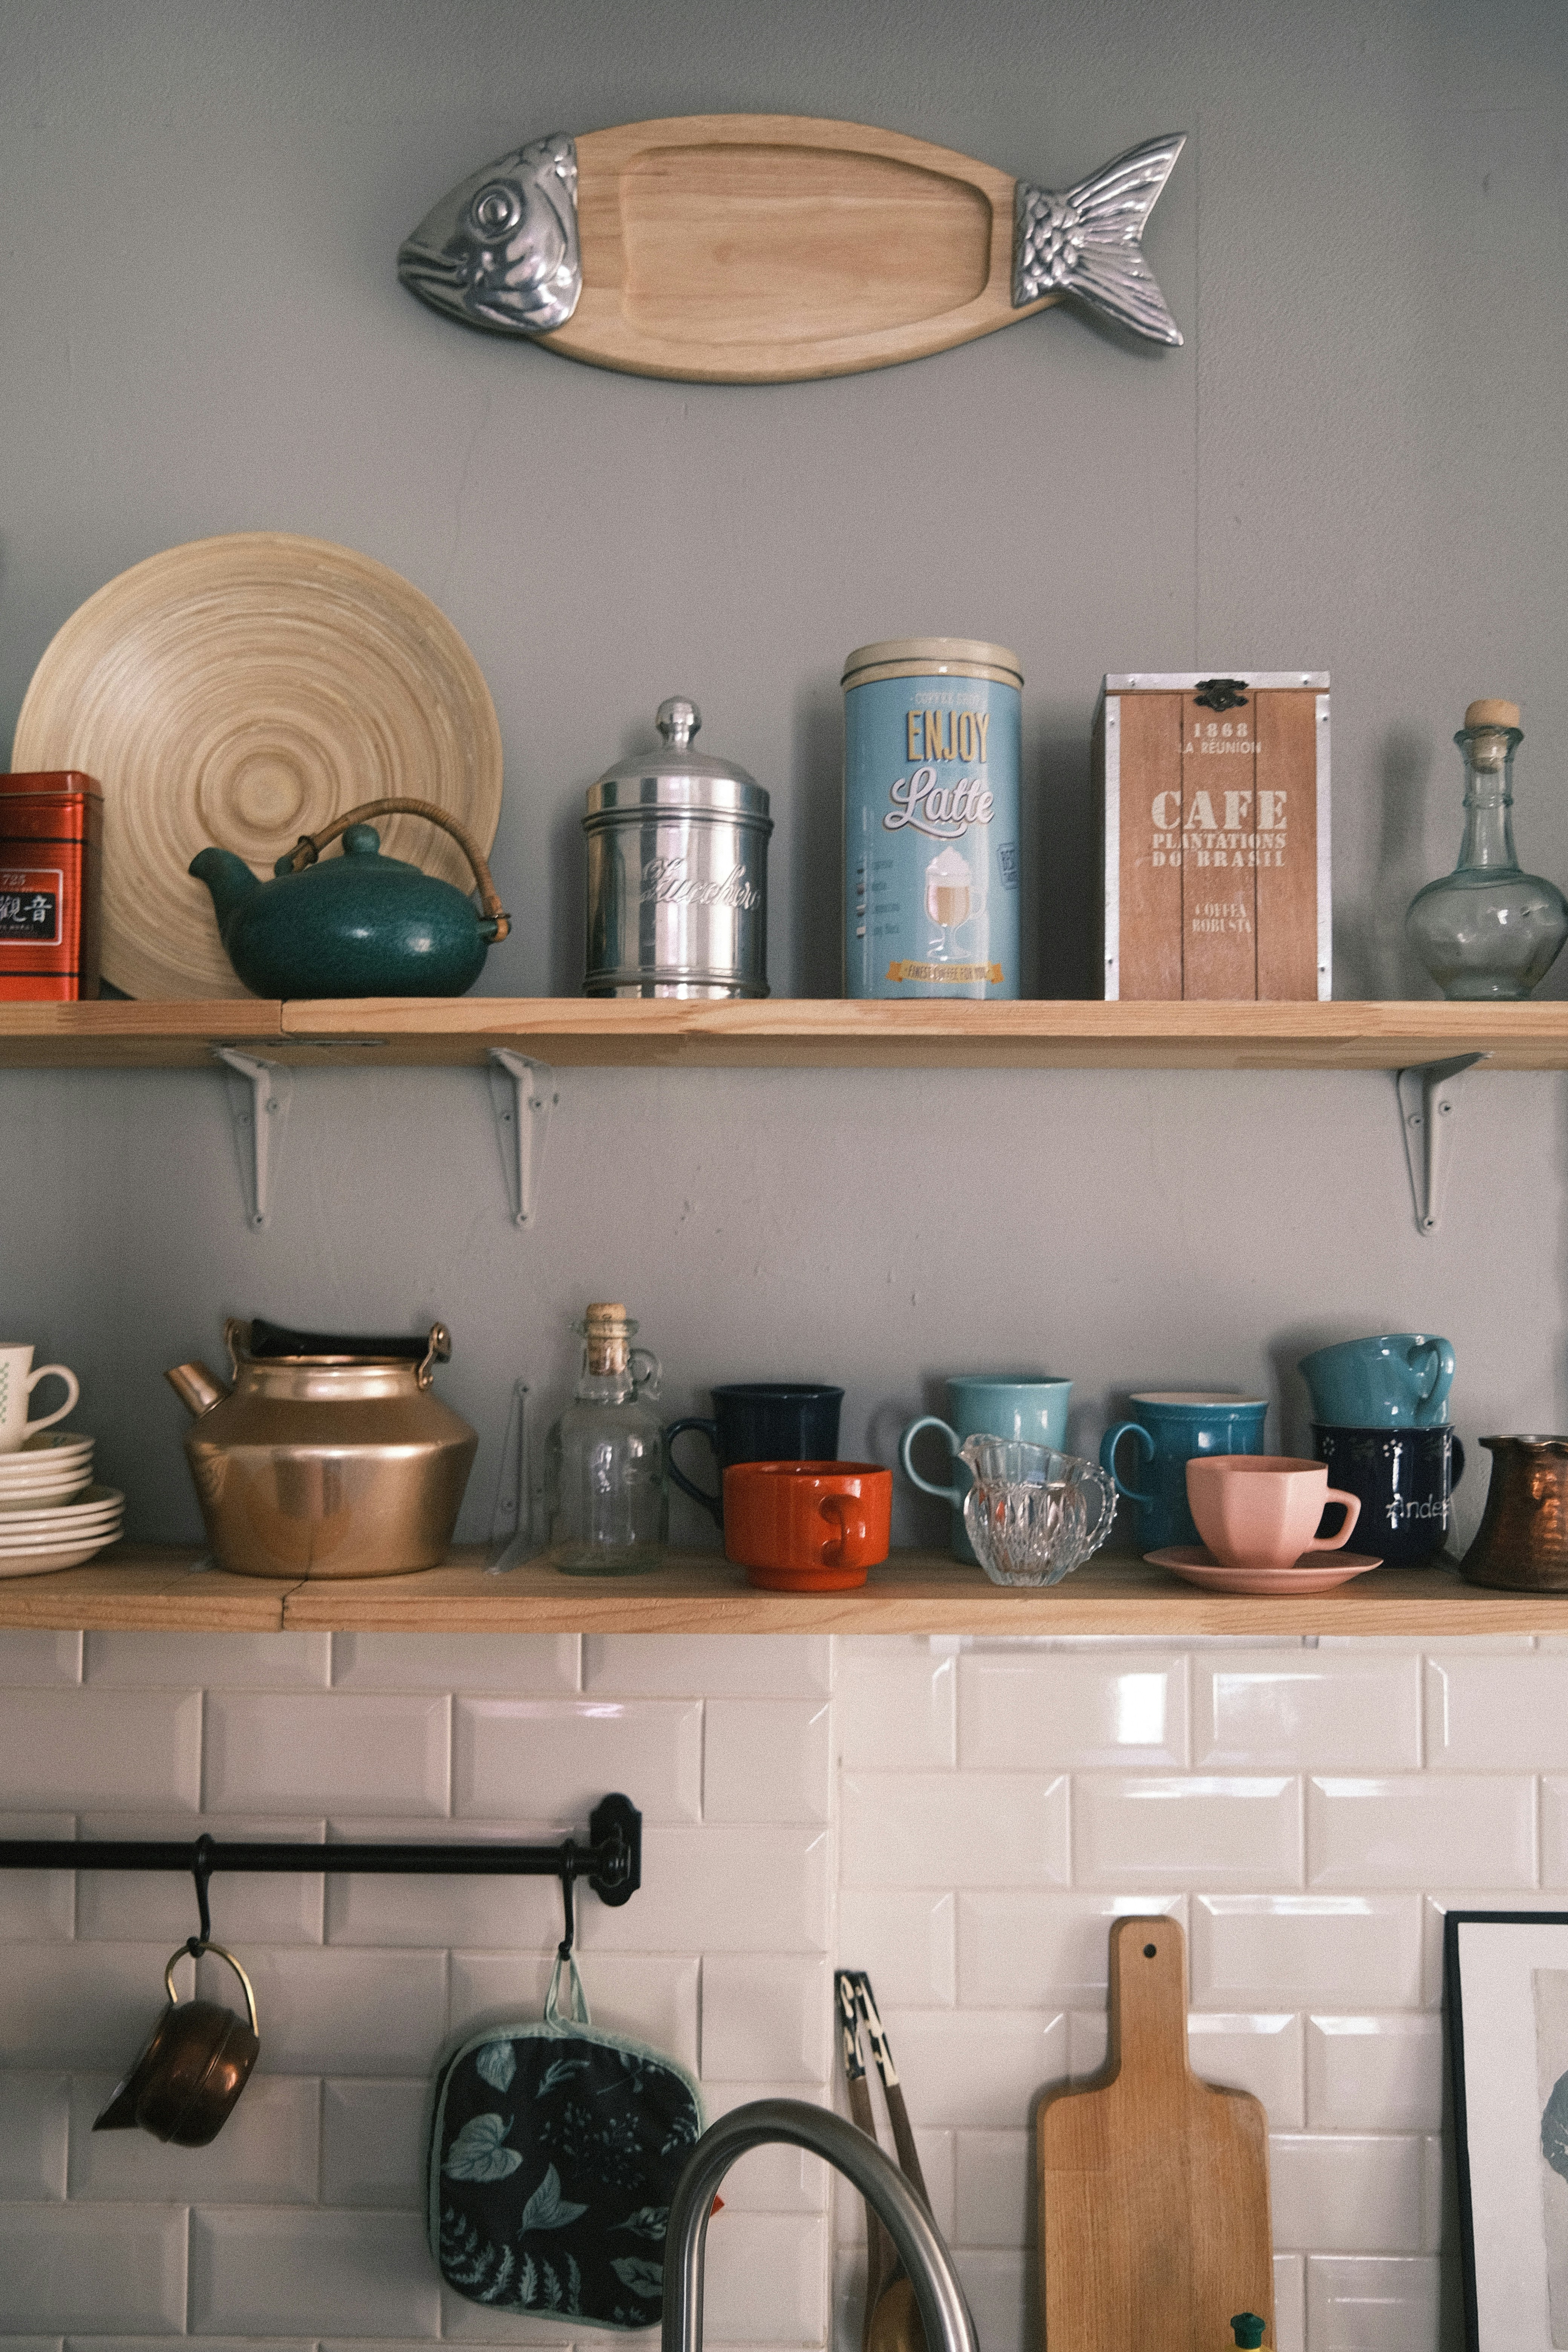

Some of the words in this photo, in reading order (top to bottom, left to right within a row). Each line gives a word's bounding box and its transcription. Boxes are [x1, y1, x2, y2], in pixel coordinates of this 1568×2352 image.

[906, 710, 990, 763] ENJOY
[1194, 723, 1248, 738] 1868
[882, 766, 995, 839] Latte
[1151, 790, 1288, 830] CAFE
[1152, 833, 1287, 849] PLANTATIONS
[1152, 851, 1182, 867] DO
[1196, 851, 1286, 868] BRASIL
